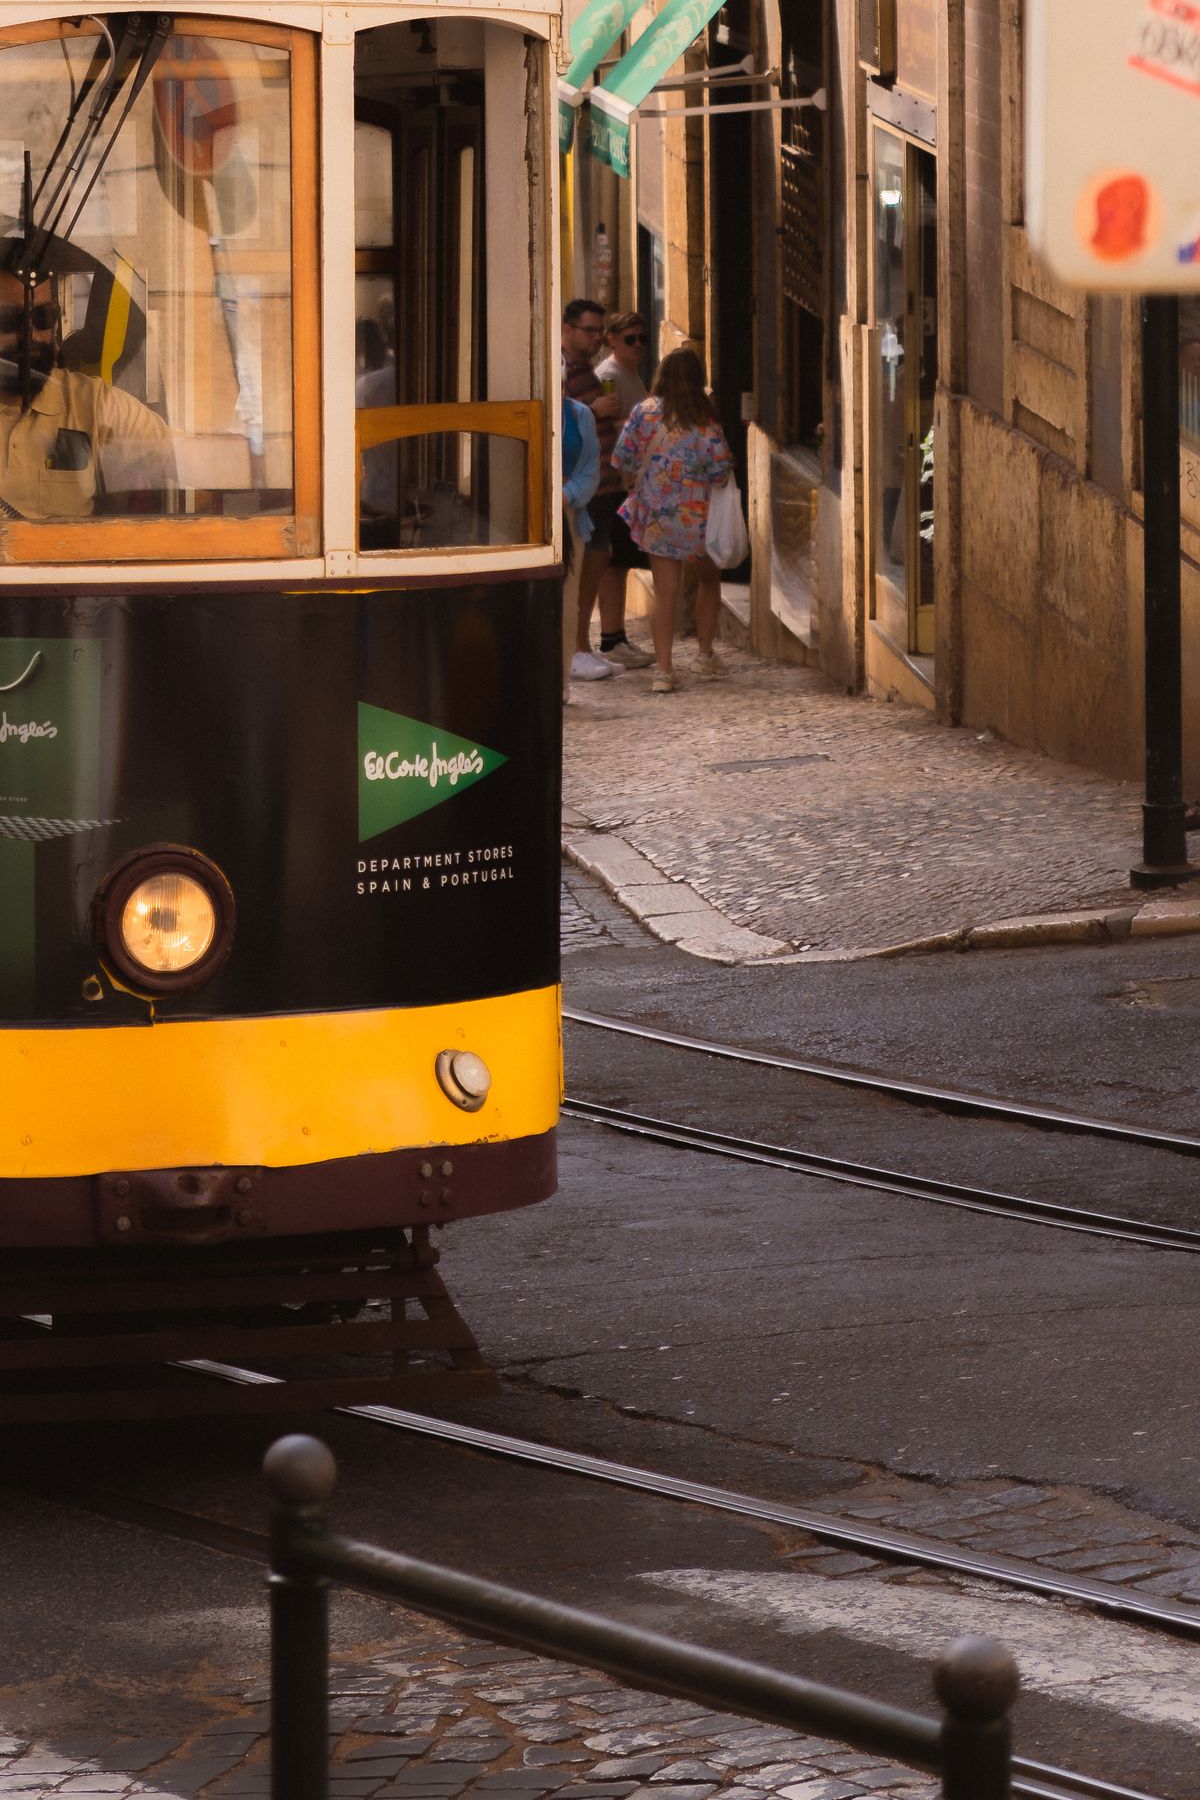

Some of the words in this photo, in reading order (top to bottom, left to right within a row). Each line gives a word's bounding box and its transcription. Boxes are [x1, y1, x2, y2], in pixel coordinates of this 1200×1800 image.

[0, 711, 58, 744] Inglés
[363, 751, 385, 781] El
[385, 751, 429, 780] Corte
[428, 741, 484, 788] Inglés
[357, 852, 462, 873] DEPARTMENT
[468, 845, 513, 863] STORES
[357, 878, 412, 895] SPAIN
[422, 877, 431, 889] &
[441, 867, 514, 887] PORTUGAL
